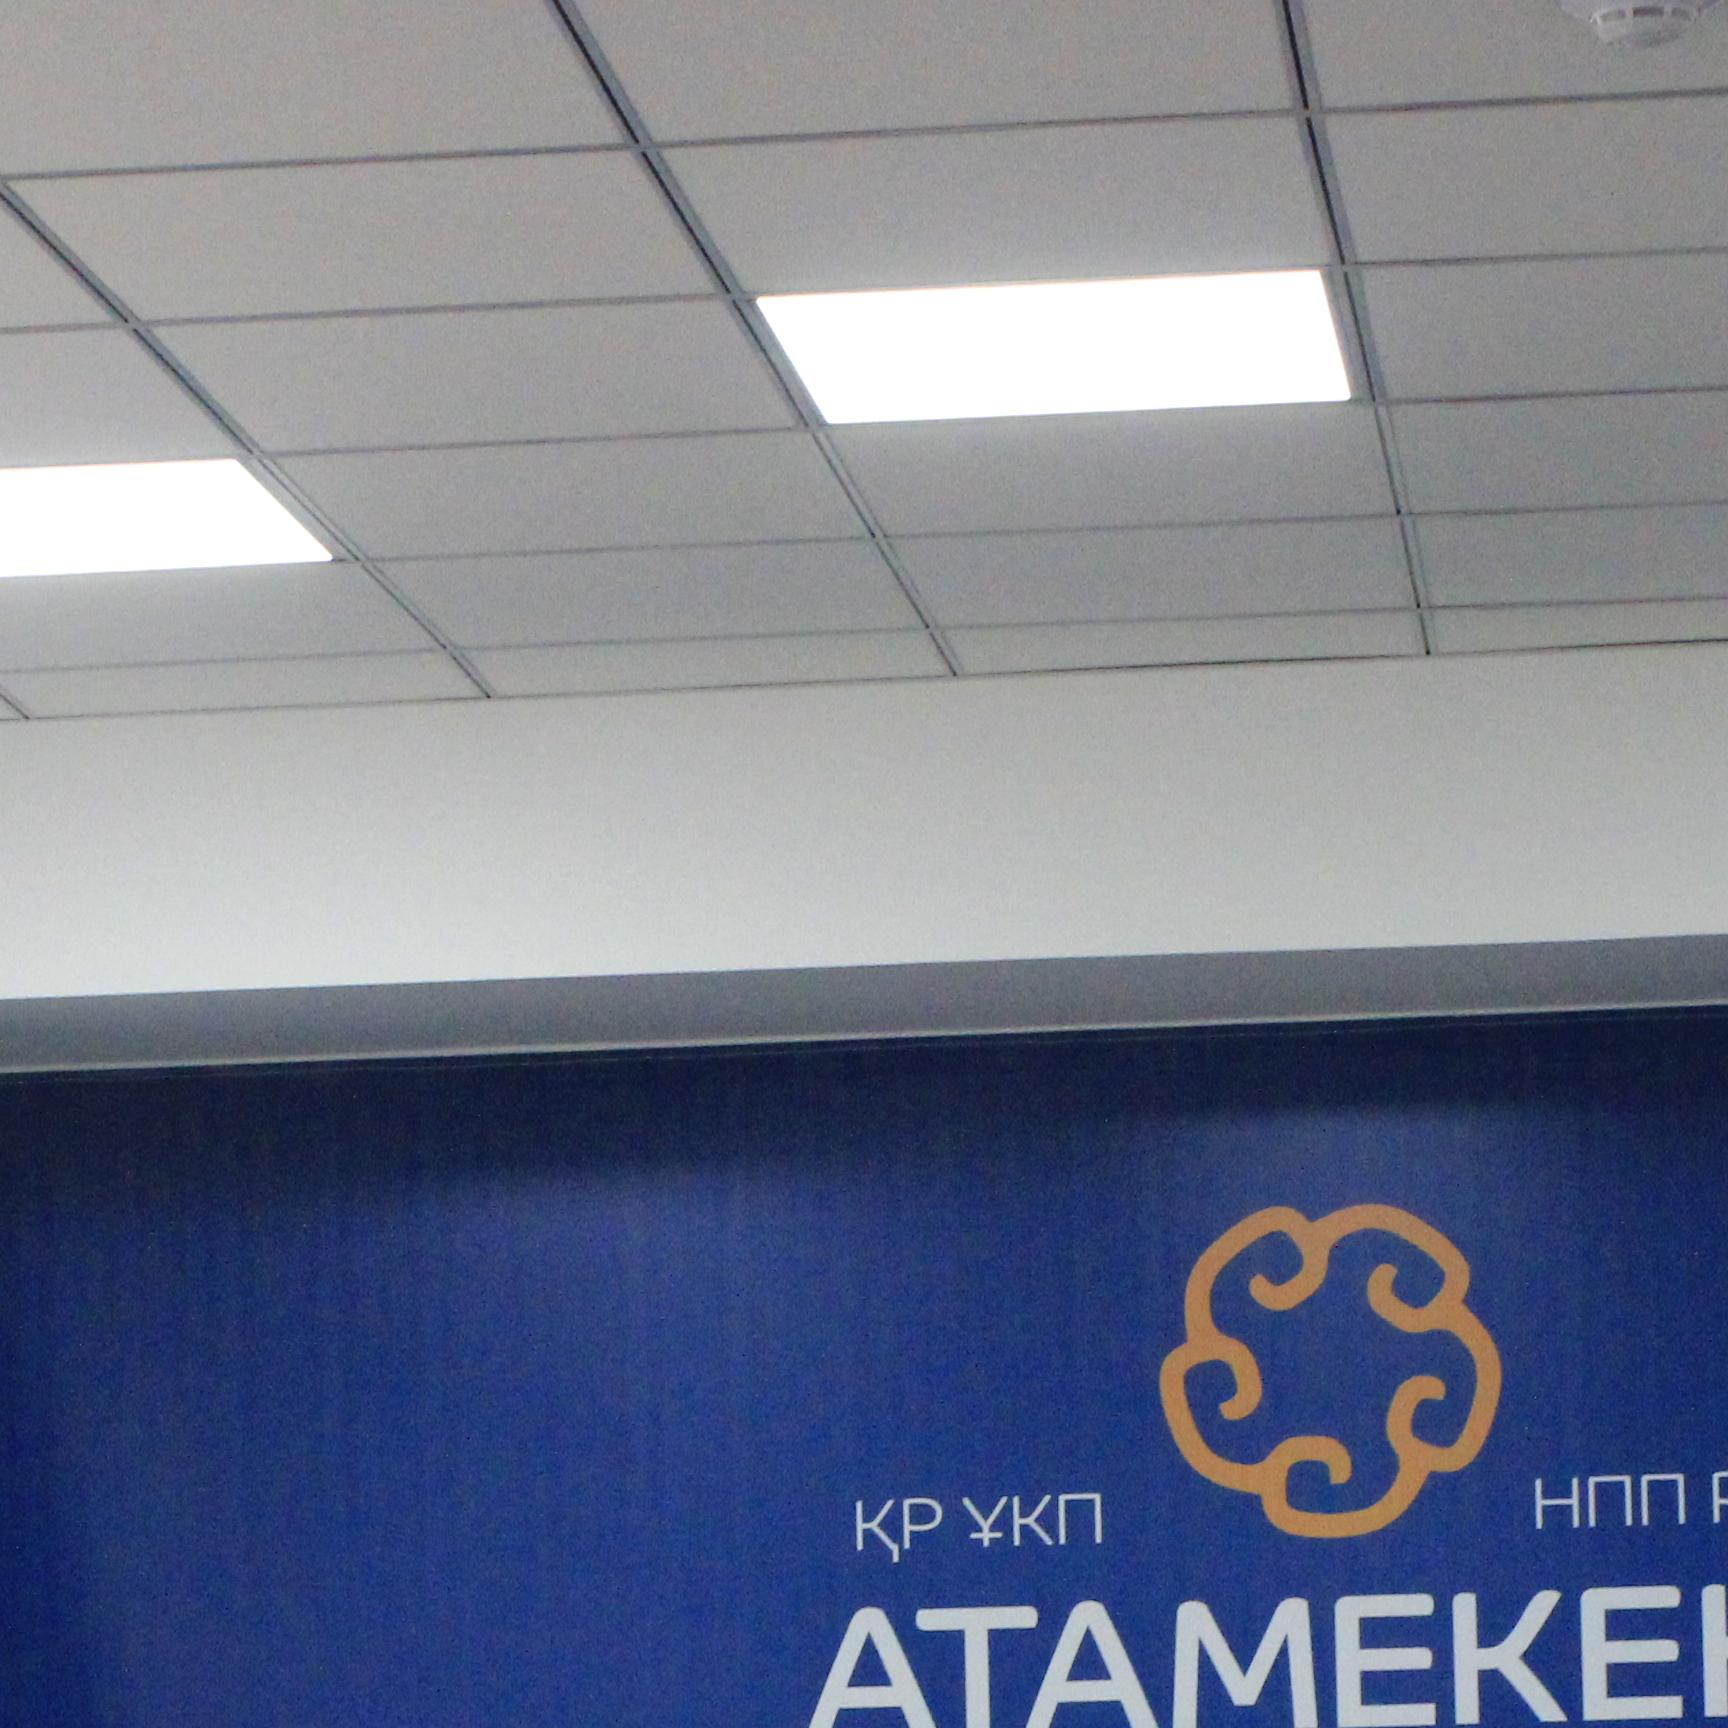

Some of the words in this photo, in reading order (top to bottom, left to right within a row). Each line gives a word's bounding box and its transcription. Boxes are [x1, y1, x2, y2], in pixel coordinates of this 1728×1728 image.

[854, 1498, 943, 1563] ҚР
[962, 1491, 1103, 1549] ҰКП
[1534, 1473, 1685, 1530] НПП
